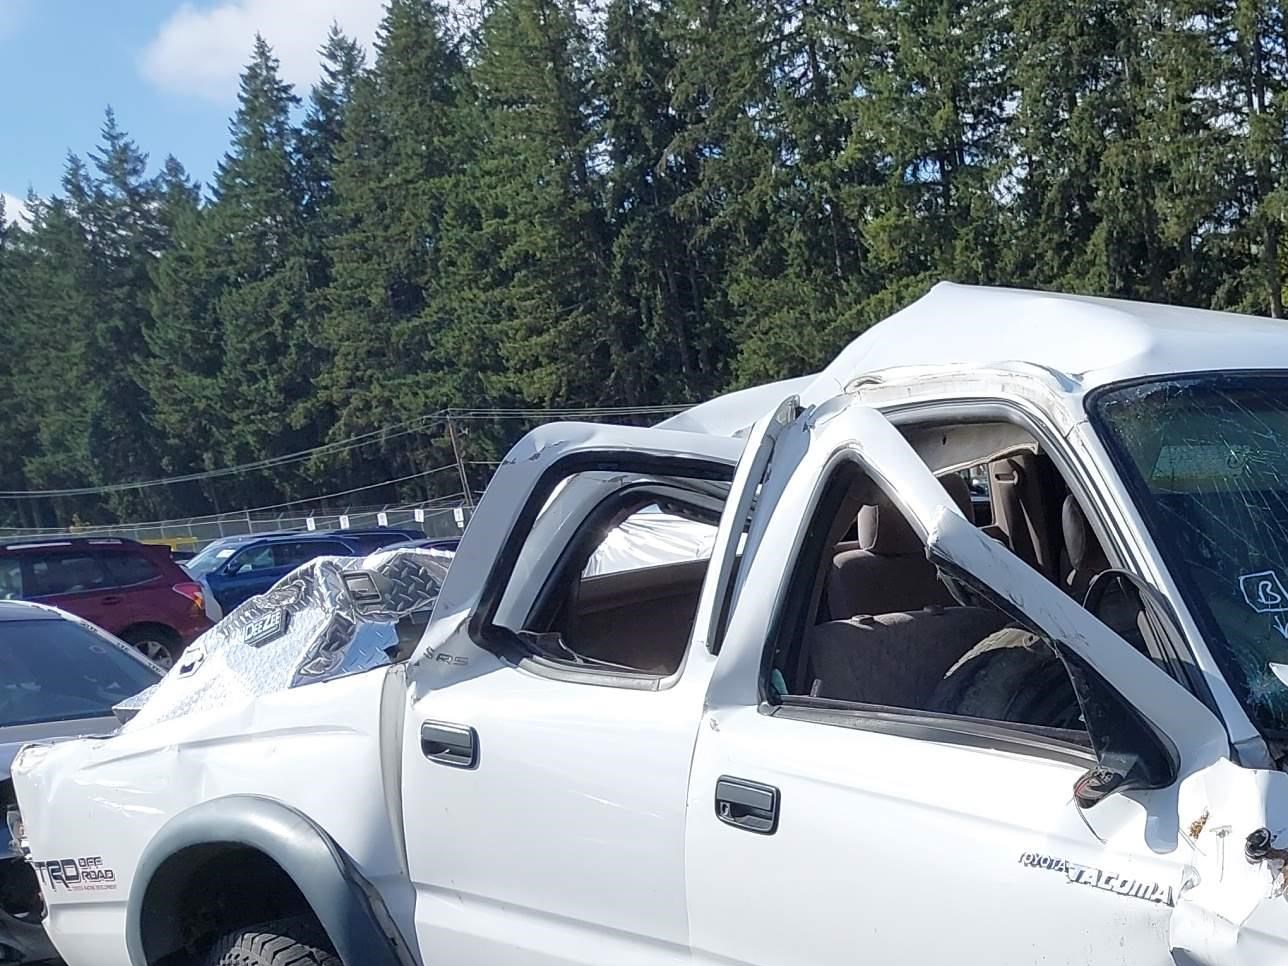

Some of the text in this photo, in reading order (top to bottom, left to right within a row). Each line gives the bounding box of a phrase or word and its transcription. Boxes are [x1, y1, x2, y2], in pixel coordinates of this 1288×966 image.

[33, 856, 103, 891] TRD OFF
[81, 869, 115, 881] ROAD
[1018, 851, 1175, 908] TOYOTA TACOMA
